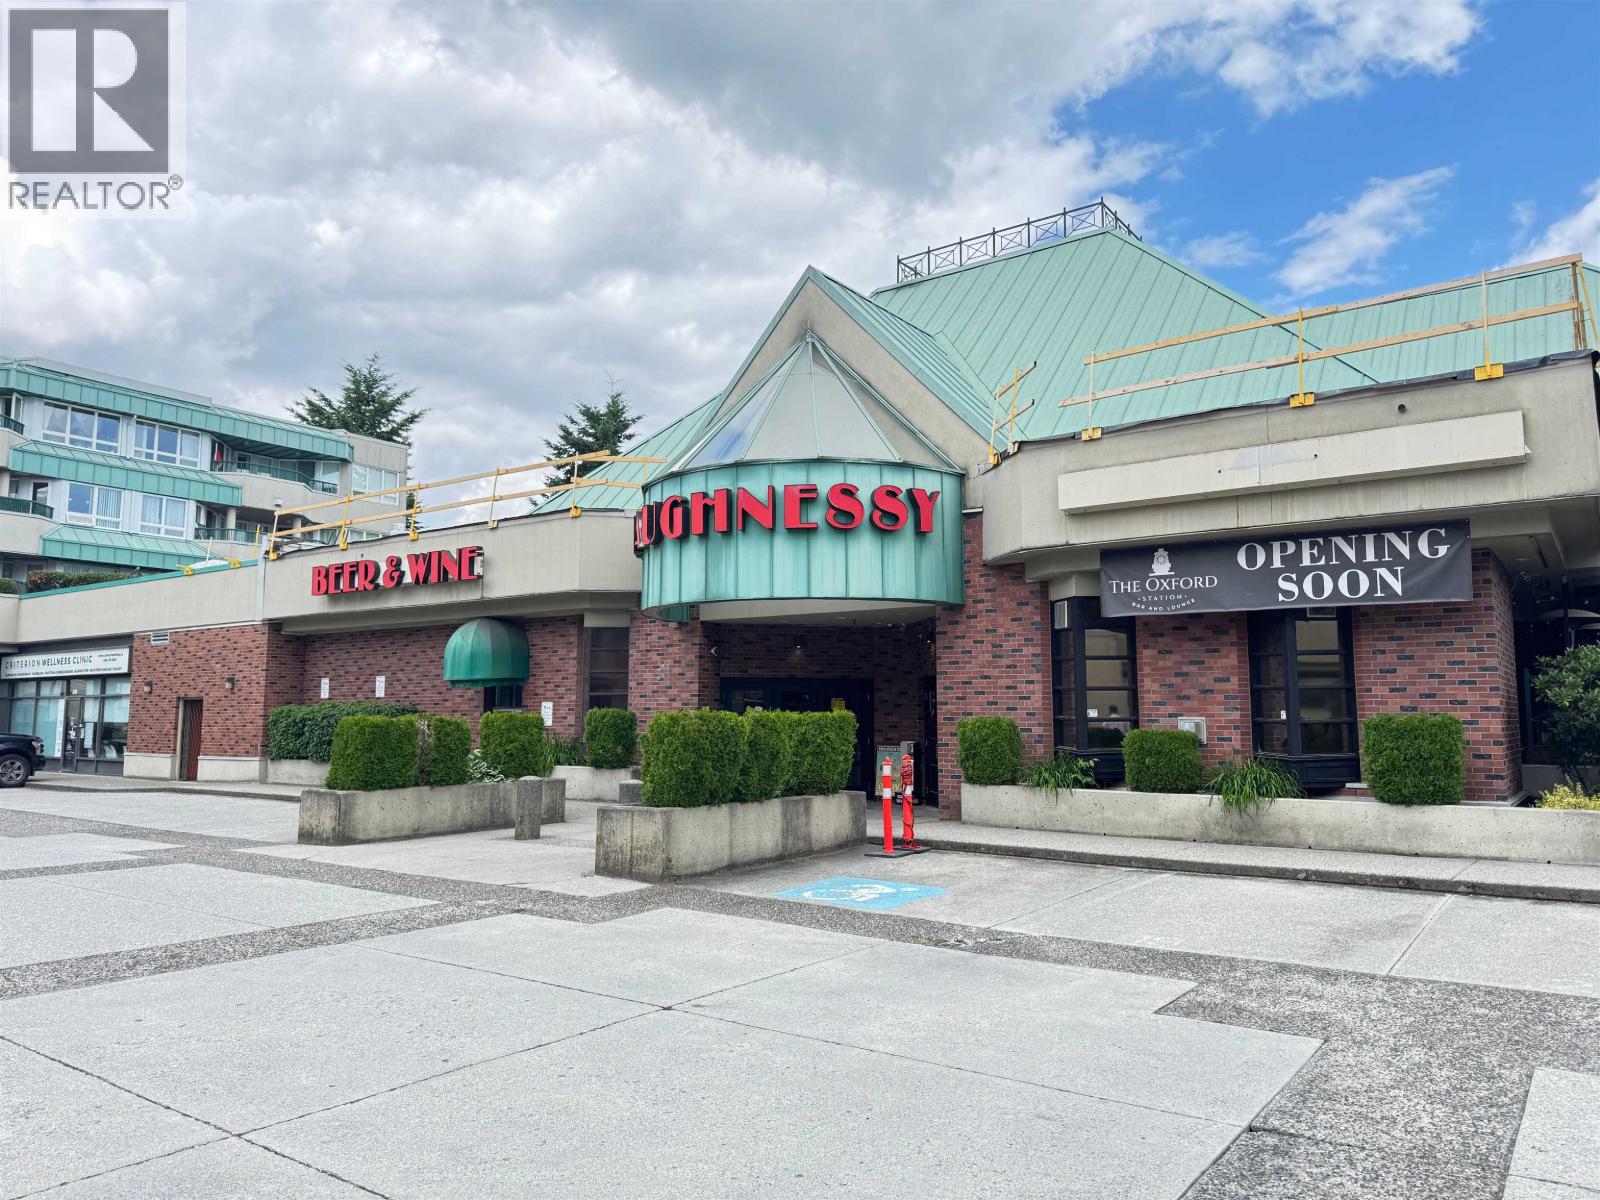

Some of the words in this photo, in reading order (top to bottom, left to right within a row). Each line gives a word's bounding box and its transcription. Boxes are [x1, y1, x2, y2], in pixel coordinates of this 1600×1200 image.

[1236, 528, 1450, 571] OPENING
[312, 559, 379, 597] BEER
[407, 546, 482, 585] WINE
[1109, 580, 1142, 594] THE
[1145, 575, 1218, 592] OXFORD
[1277, 566, 1405, 602] SOON
[1131, 602, 1146, 610] BAR
[1166, 598, 1196, 611] LOUNGE
[1142, 594, 1183, 602] STATION
[41, 656, 72, 667] WELLNESS
[72, 655, 93, 665] CLINIC
